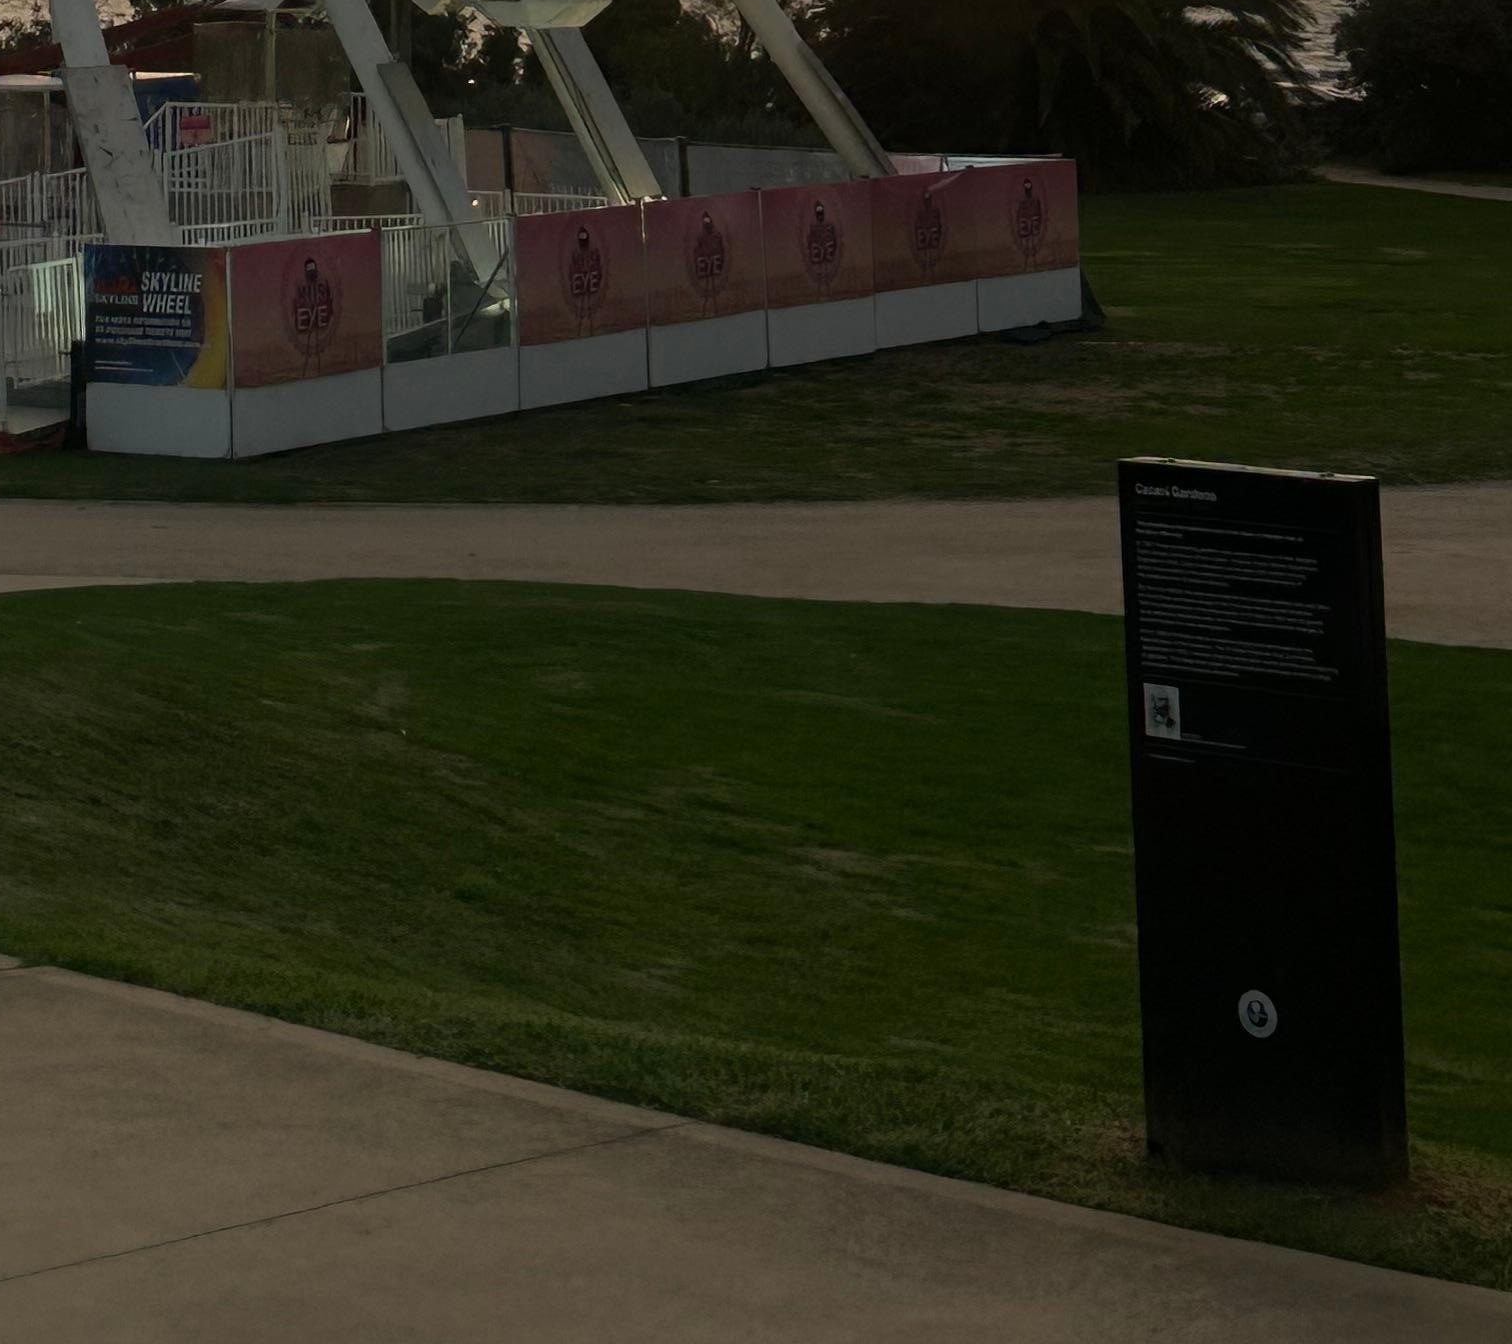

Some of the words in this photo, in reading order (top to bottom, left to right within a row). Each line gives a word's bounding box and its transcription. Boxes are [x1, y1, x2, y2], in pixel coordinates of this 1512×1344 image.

[696, 255, 721, 276] EYE
[141, 271, 202, 293] SKYLINE
[572, 271, 600, 294] EYE
[142, 294, 192, 315] WHEEL
[296, 305, 329, 330] EYE
